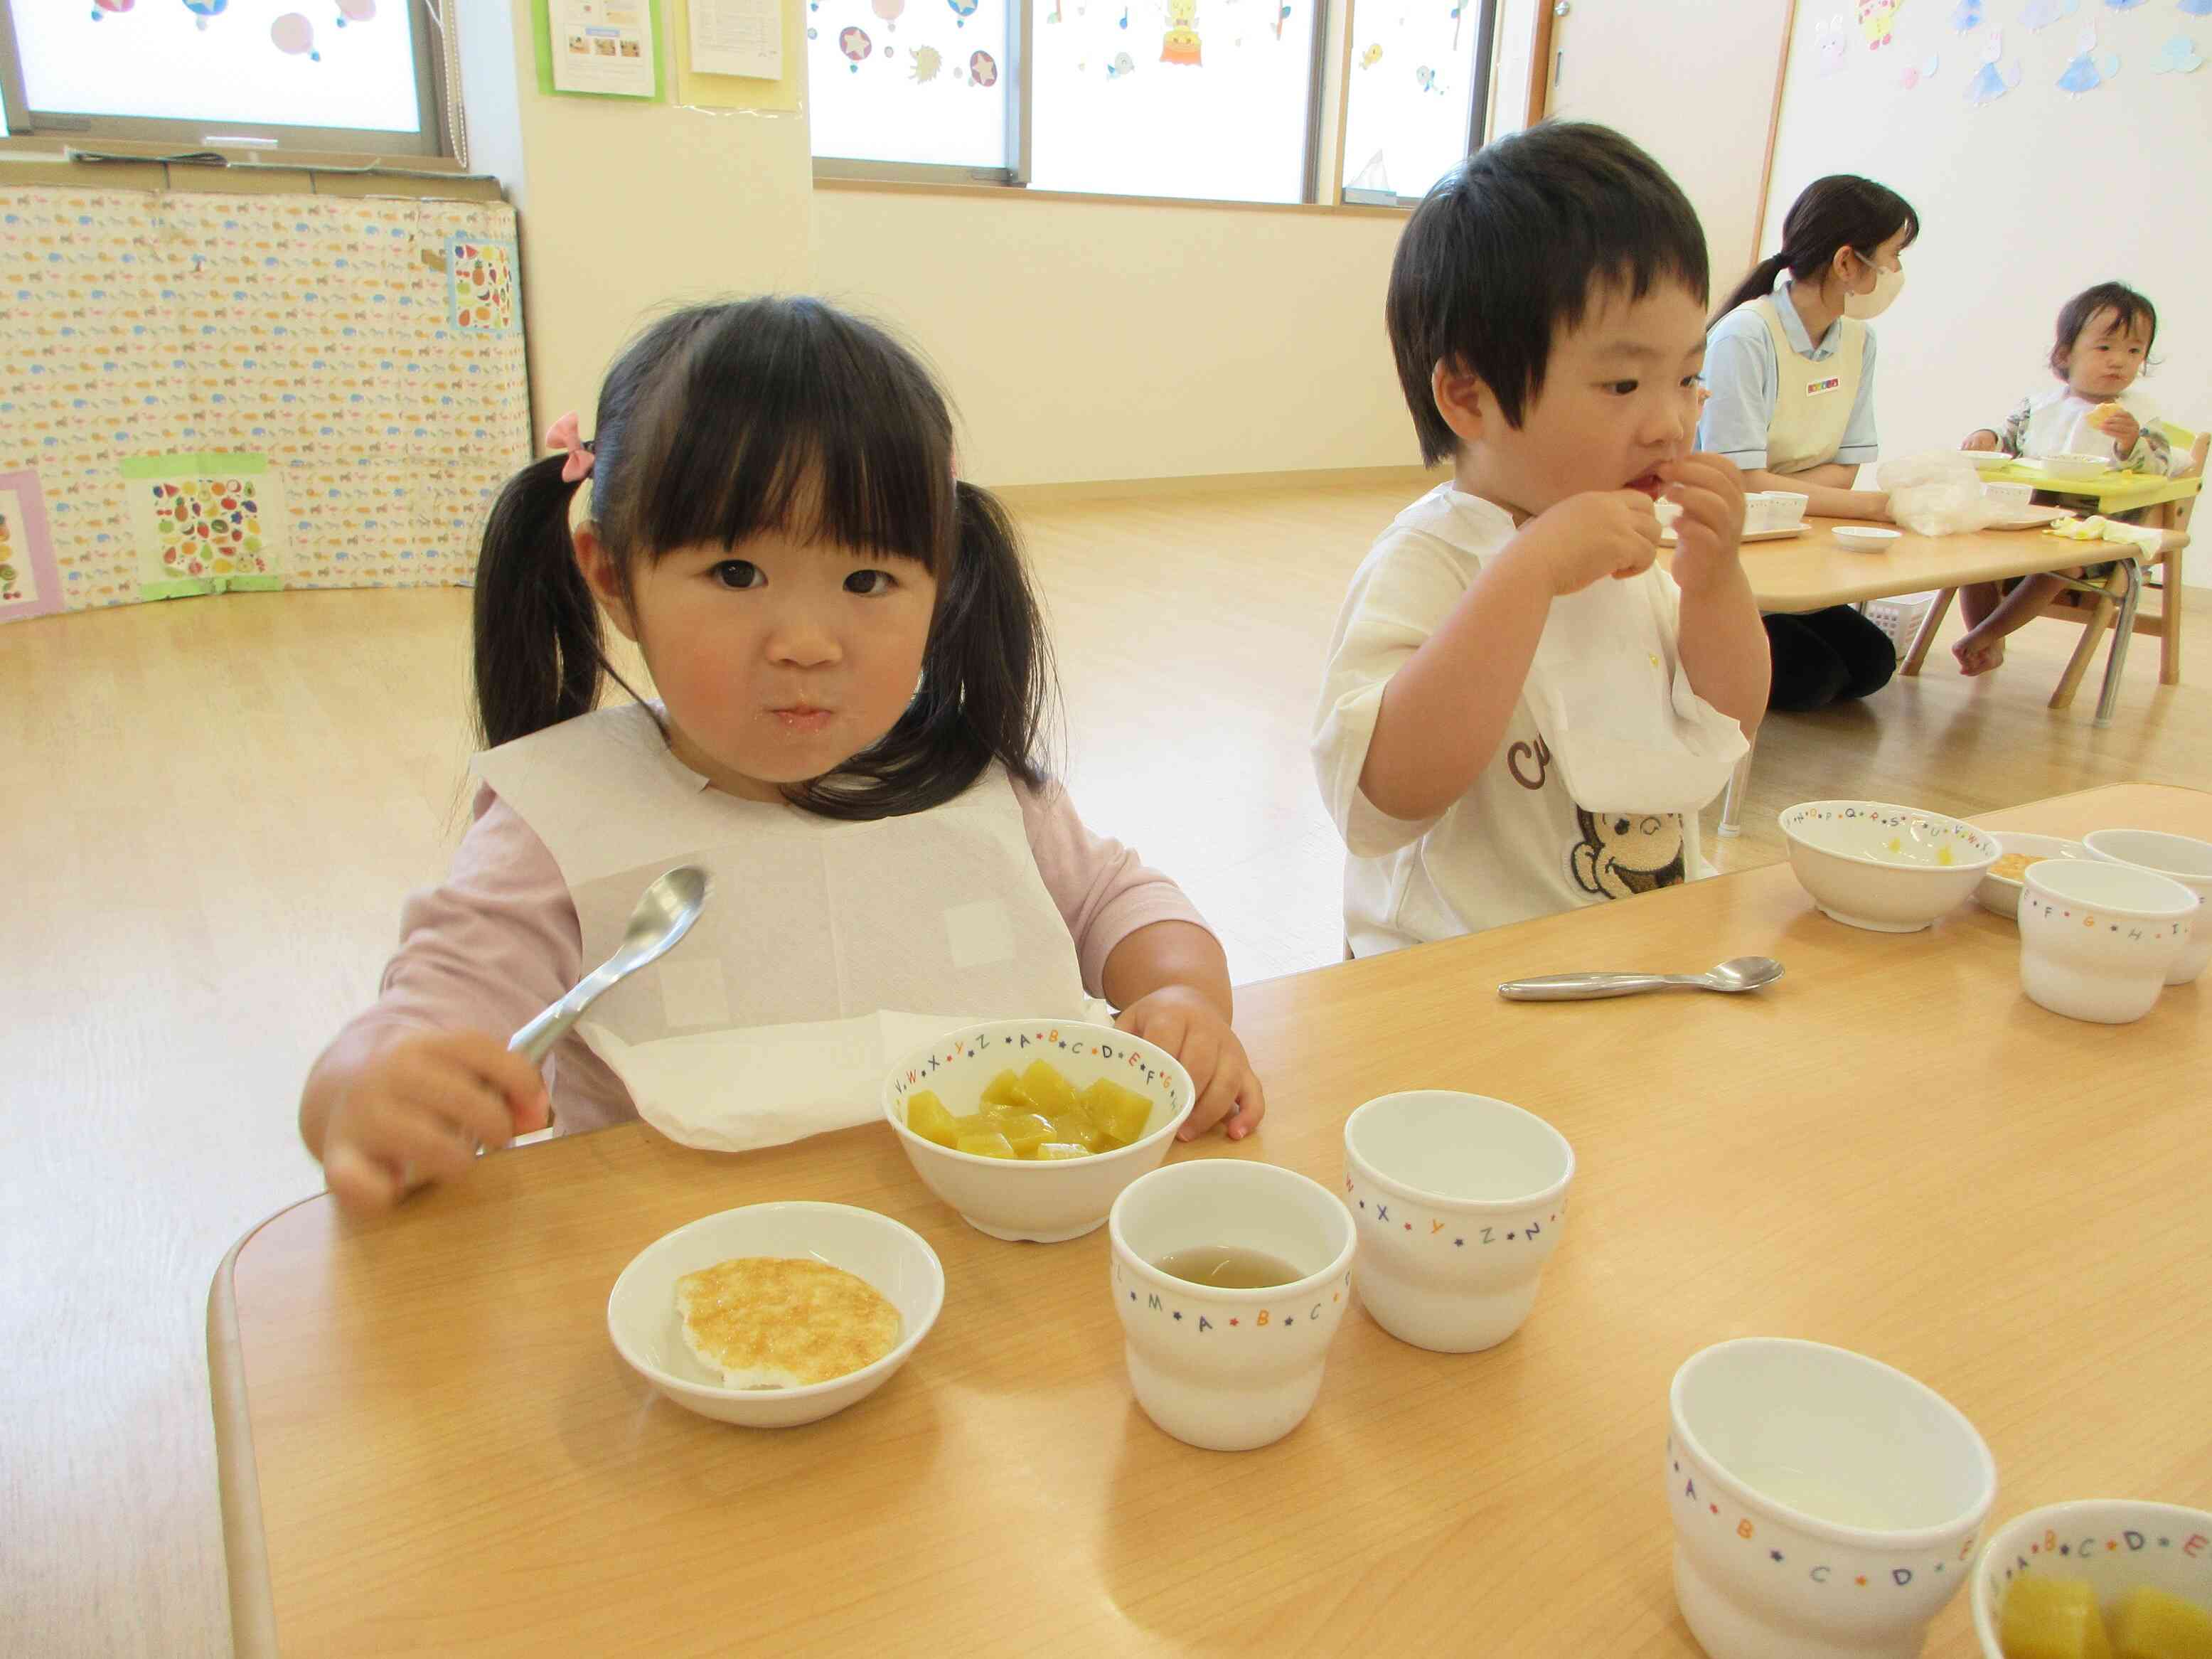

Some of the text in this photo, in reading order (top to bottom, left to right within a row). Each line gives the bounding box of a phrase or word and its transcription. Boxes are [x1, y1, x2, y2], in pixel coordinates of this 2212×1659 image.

[1845, 808, 1856, 818] Q
[1890, 817, 1899, 827] S
[2044, 906, 2053, 919] F
[907, 1069, 917, 1084] W
[928, 1055, 940, 1071] X
[955, 1041, 963, 1055] Y
[976, 1034, 990, 1049] Z
[1020, 1034, 1030, 1049] A
[1049, 1029, 1058, 1042] B
[1072, 1042, 1083, 1054] C
[1102, 1045, 1113, 1058] D
[1128, 1052, 1140, 1067] E
[1146, 1070, 1155, 1085] F
[1377, 1204, 1389, 1222] X
[1431, 1217, 1445, 1234] Y
[1480, 1227, 1495, 1244] Z
[1149, 1293, 1163, 1312] M
[1199, 1316, 1213, 1333] A
[1256, 1308, 1269, 1326] B
[1310, 1303, 1321, 1321] C
[1685, 1478, 1697, 1501] A
[1736, 1518, 1753, 1539] B
[1810, 1566, 1830, 1583] C
[1893, 1569, 1912, 1586] D
[2044, 1529, 2056, 1552] B
[2078, 1538, 2095, 1558] C
[2123, 1530, 2144, 1551] D
[2183, 1534, 2208, 1558] E
